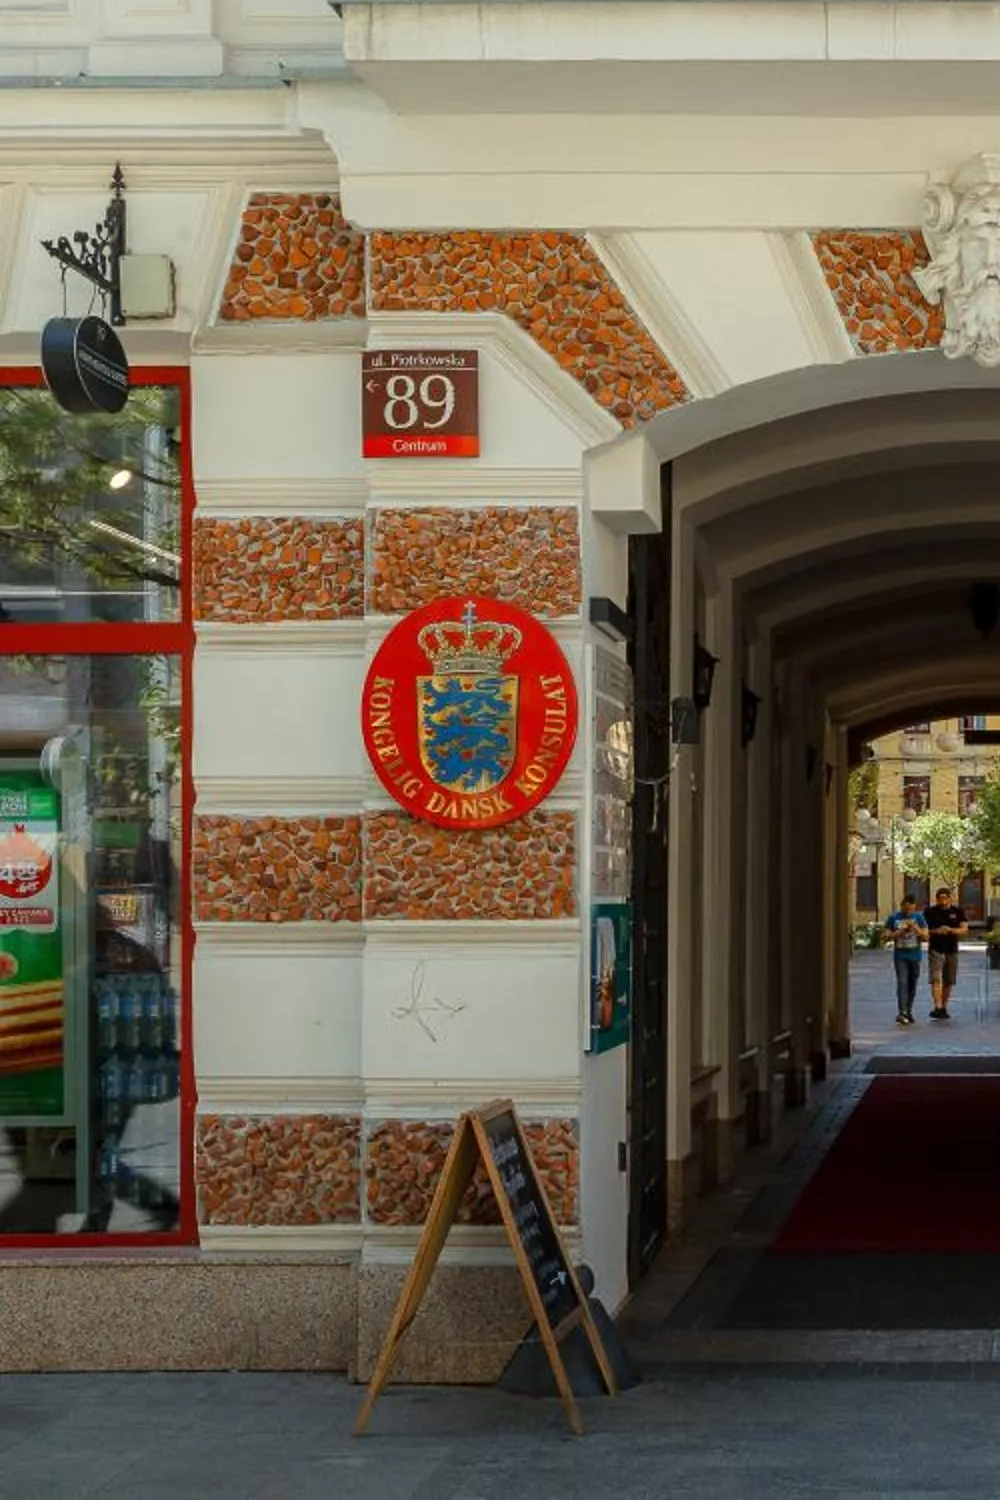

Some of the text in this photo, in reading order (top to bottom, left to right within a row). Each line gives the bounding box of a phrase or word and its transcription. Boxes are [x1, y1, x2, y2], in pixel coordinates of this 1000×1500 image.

[371, 353, 465, 367] ul. Piotrkowska
[384, 375, 456, 429] 89
[392, 439, 447, 453] Centrum
[370, 674, 567, 819] KONGELIG DANSK KONSULAT
